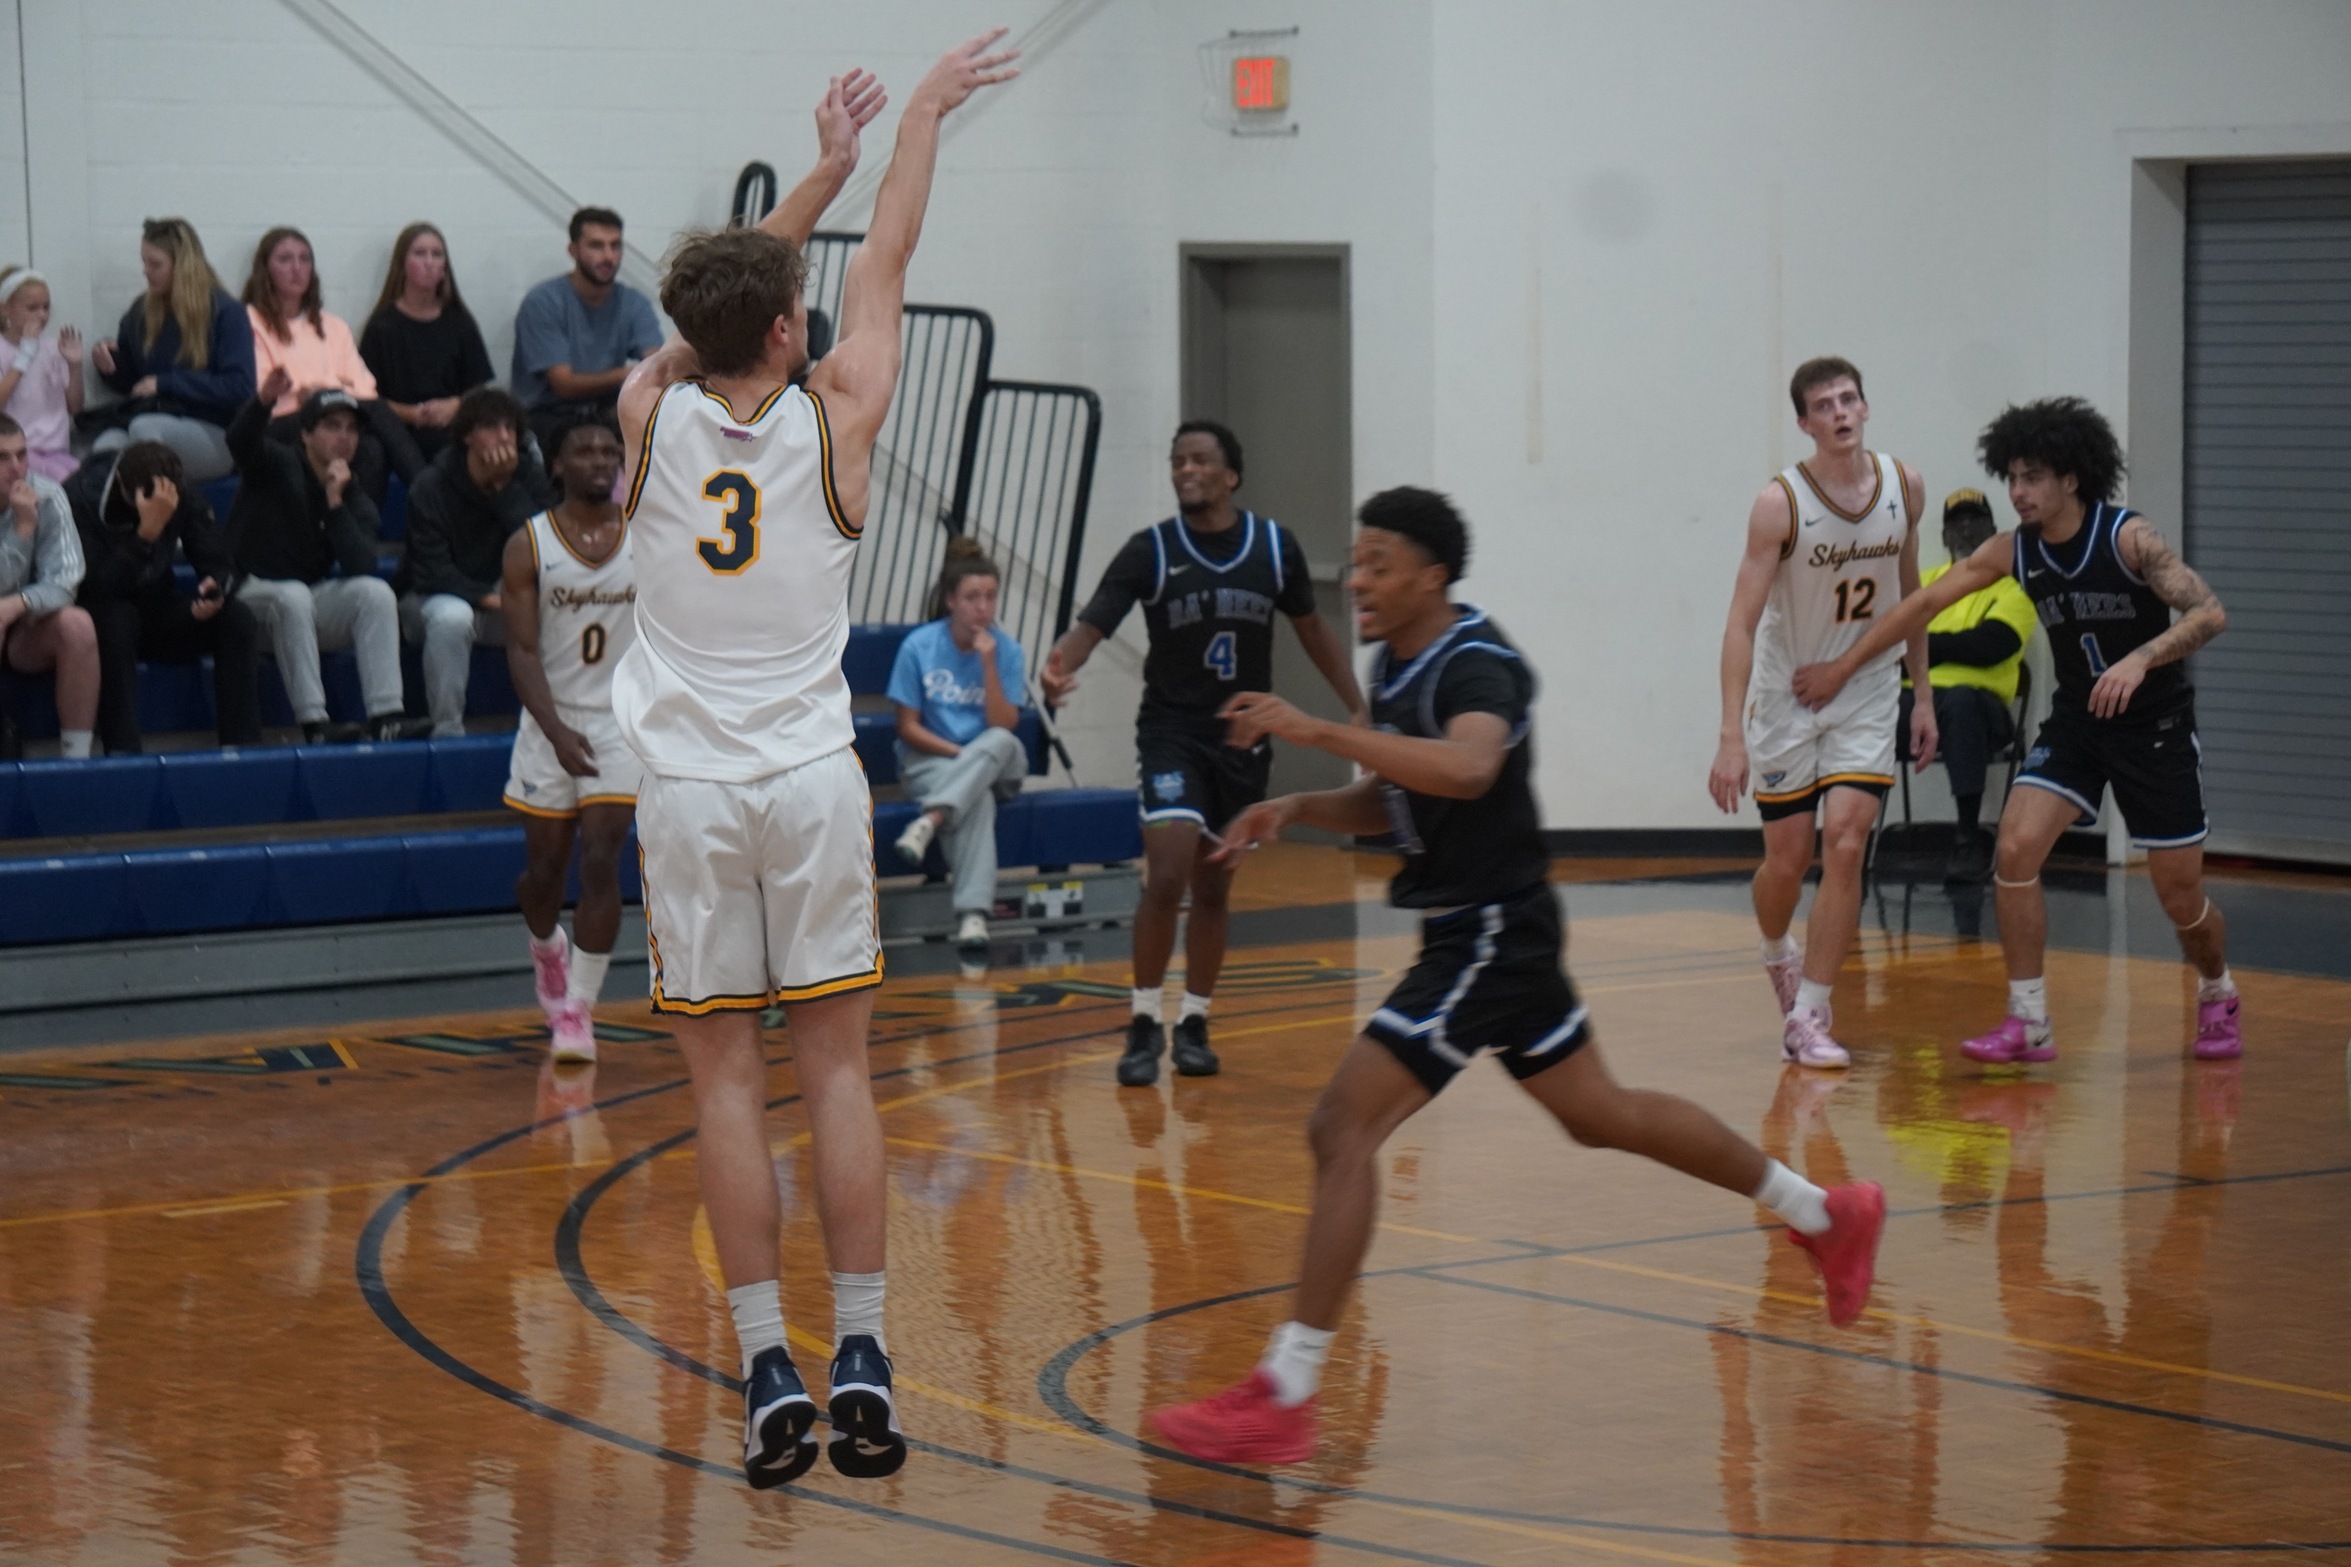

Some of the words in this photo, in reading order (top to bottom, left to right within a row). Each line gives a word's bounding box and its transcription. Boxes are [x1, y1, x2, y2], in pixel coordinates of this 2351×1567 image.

[1237, 58, 1275, 107] EXIT
[695, 468, 762, 576] 3
[1808, 535, 1900, 573] Skyhawks
[551, 584, 637, 612] Skyhawk
[1834, 576, 1876, 625] 12
[581, 621, 607, 666] 0
[1204, 631, 1237, 681] 4
[2080, 632, 2108, 678] 1
[923, 668, 987, 705] Poin
